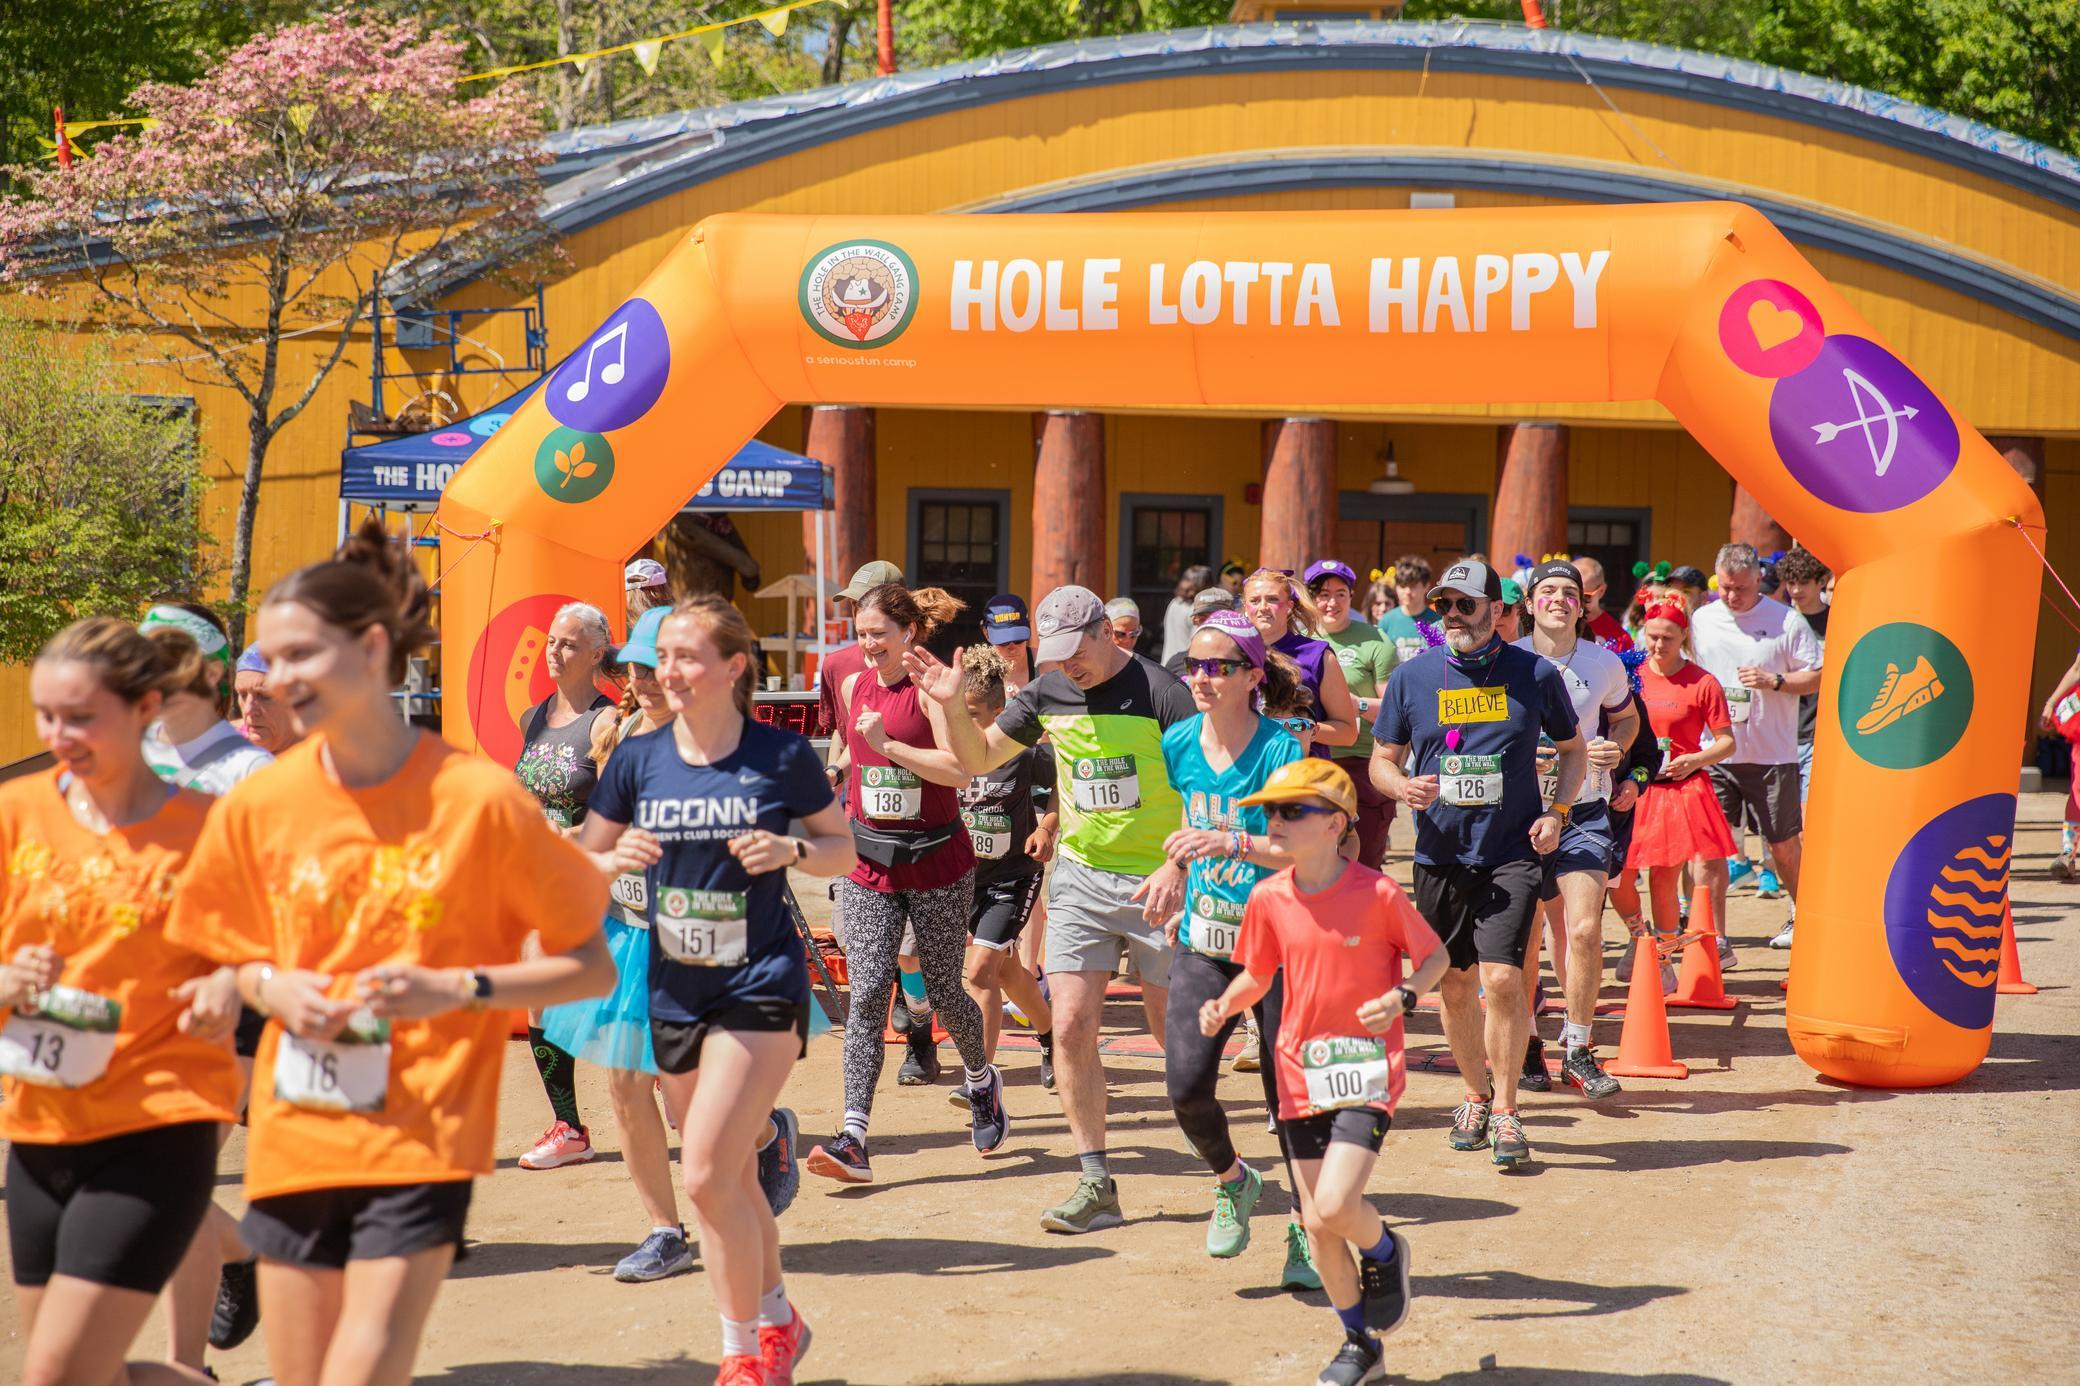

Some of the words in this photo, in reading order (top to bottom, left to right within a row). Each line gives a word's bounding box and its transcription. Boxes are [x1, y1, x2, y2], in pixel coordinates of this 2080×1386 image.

[827, 257, 840, 267] IN
[841, 249, 861, 259] THE
[865, 249, 891, 264] WALL
[813, 267, 829, 292] HOLE
[889, 262, 904, 289] GANG
[950, 258, 1121, 333] HOLE
[1149, 260, 1342, 326] LOTTA
[1368, 250, 1610, 333] HAPPY
[812, 296, 825, 317] THE
[890, 292, 904, 321] CAMP
[805, 356, 814, 364] a
[883, 358, 917, 368] camp
[373, 465, 409, 487] THE
[717, 468, 793, 498] CAMP
[1442, 693, 1505, 718] BELIEVE
[1089, 779, 1120, 805] 116
[1455, 779, 1485, 799] 126
[638, 797, 758, 829] UCONN
[874, 792, 902, 813] 138
[1189, 791, 1247, 830] ALL
[683, 831, 711, 842] CLUB
[712, 829, 754, 840] SOCCE
[616, 878, 643, 902] 136
[679, 926, 716, 955] 151
[1205, 926, 1236, 951] 101
[32, 1033, 64, 1072] 13
[308, 1053, 339, 1092] 16
[1324, 1070, 1362, 1099] 100
